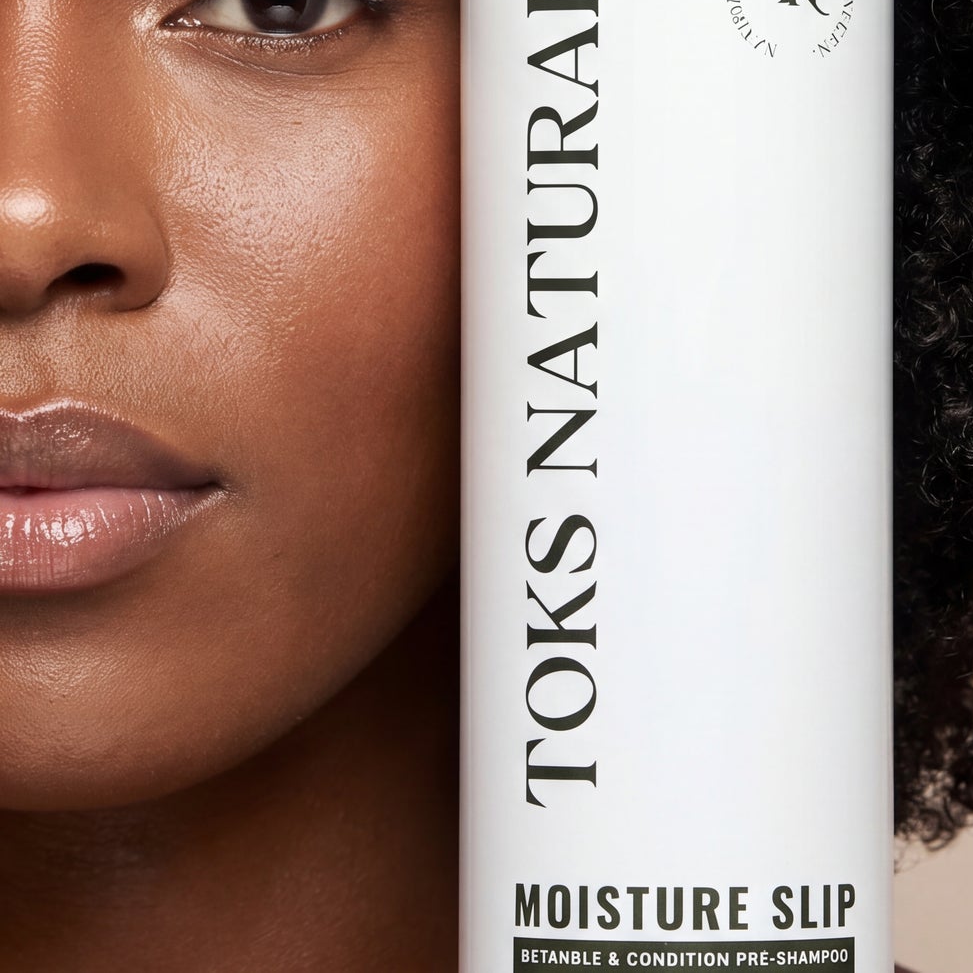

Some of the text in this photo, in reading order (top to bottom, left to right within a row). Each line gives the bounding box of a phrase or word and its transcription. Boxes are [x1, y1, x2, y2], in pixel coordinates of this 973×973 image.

[525, 515, 598, 807] TOKS
[515, 882, 856, 931] MOISTURE SLIP
[521, 949, 602, 966] BETANBLE
[608, 951, 620, 966] &
[626, 952, 730, 967] CONDITION
